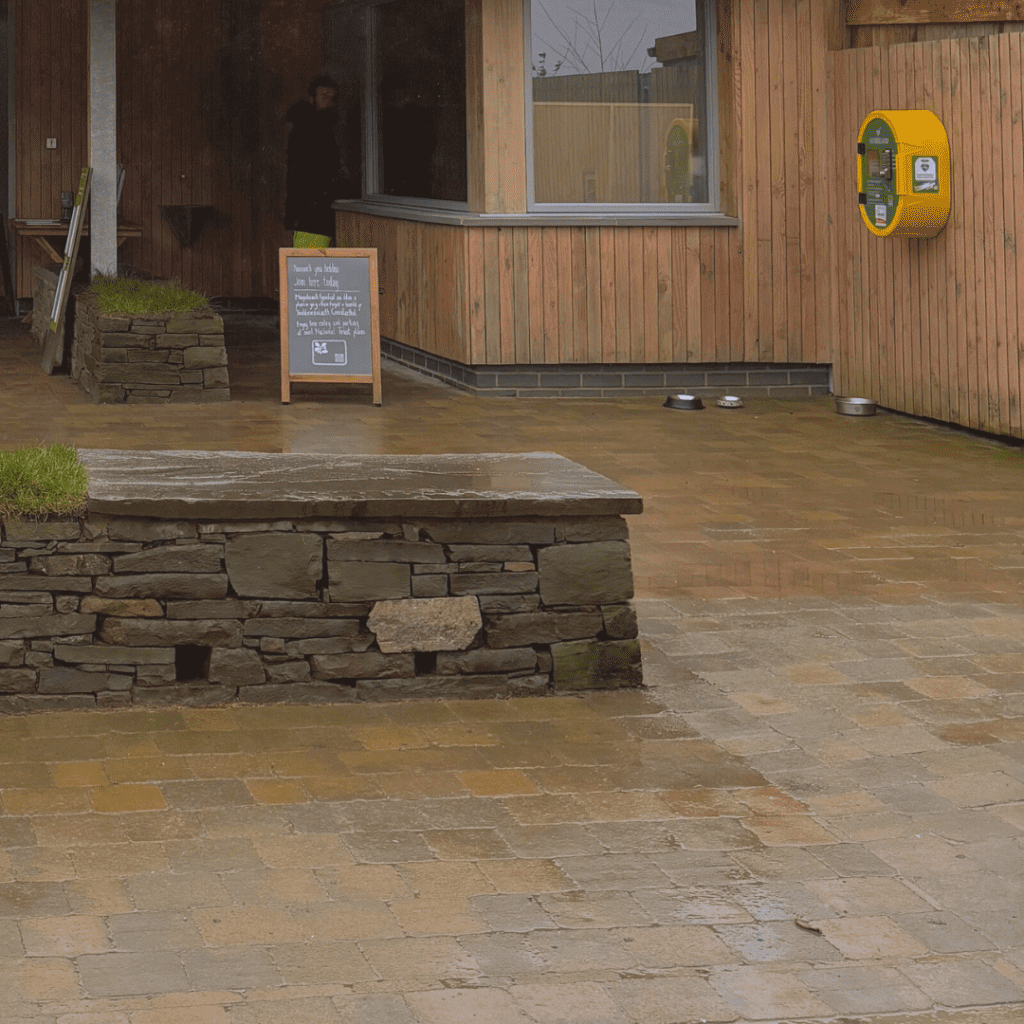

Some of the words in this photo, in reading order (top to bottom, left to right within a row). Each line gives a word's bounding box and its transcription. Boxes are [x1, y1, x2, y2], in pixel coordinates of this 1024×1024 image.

[308, 276, 320, 287] here
[323, 275, 339, 292] today
[337, 327, 351, 336] Trust
